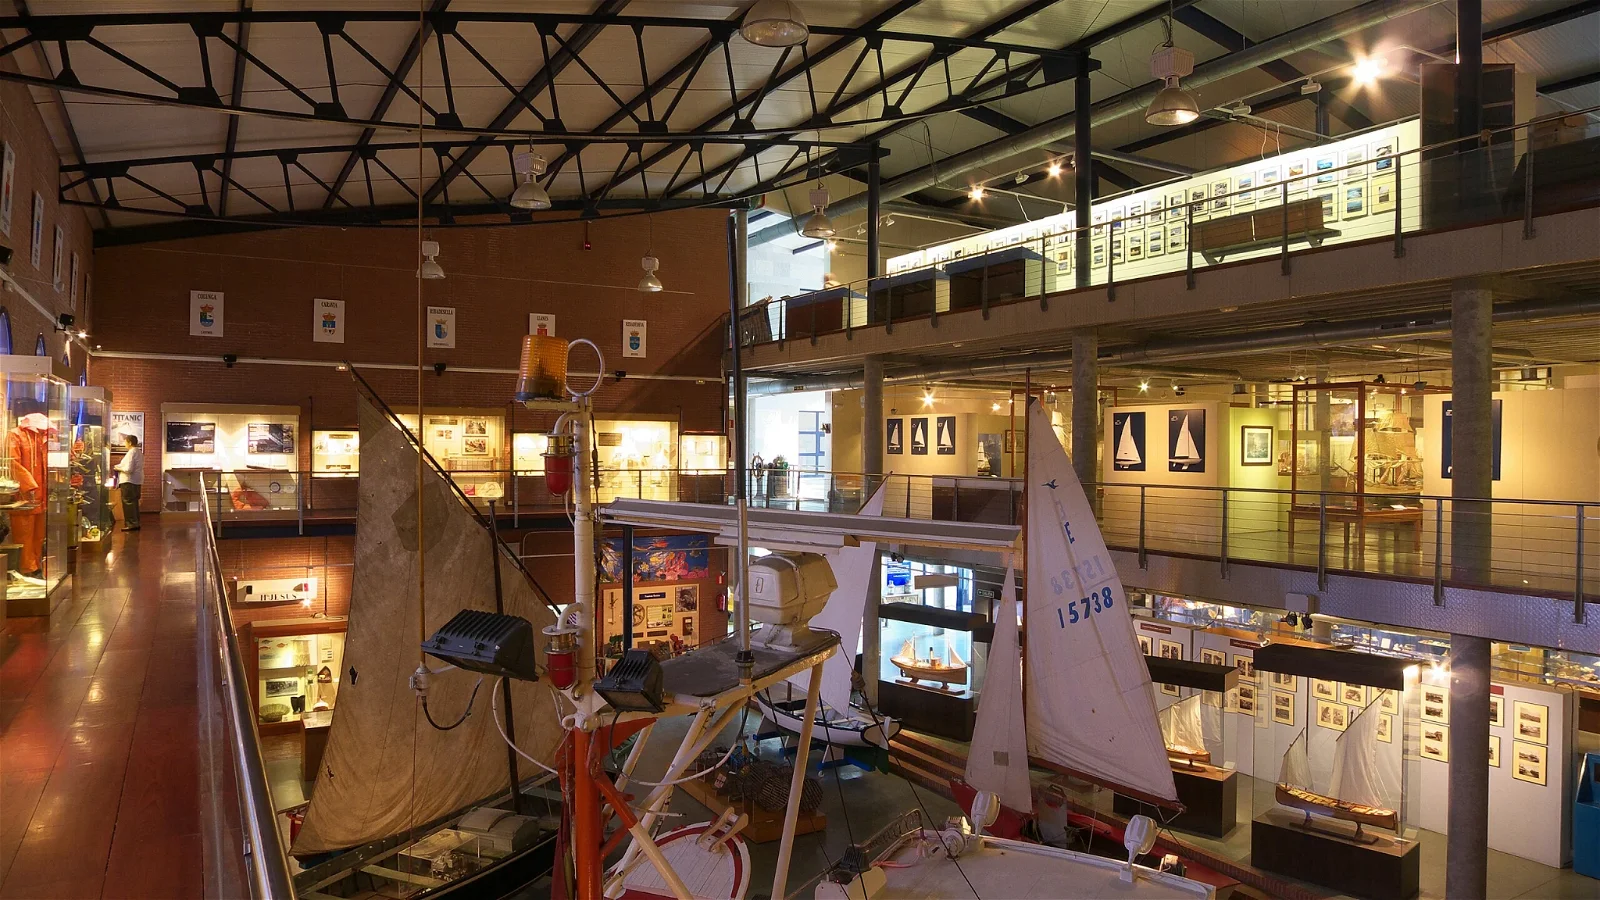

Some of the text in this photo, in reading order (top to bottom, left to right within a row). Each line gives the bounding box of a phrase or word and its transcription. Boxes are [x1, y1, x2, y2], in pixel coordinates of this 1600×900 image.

[112, 414, 142, 422] TITANIC
[1063, 521, 1076, 545] E
[1057, 586, 1114, 629] 15738
